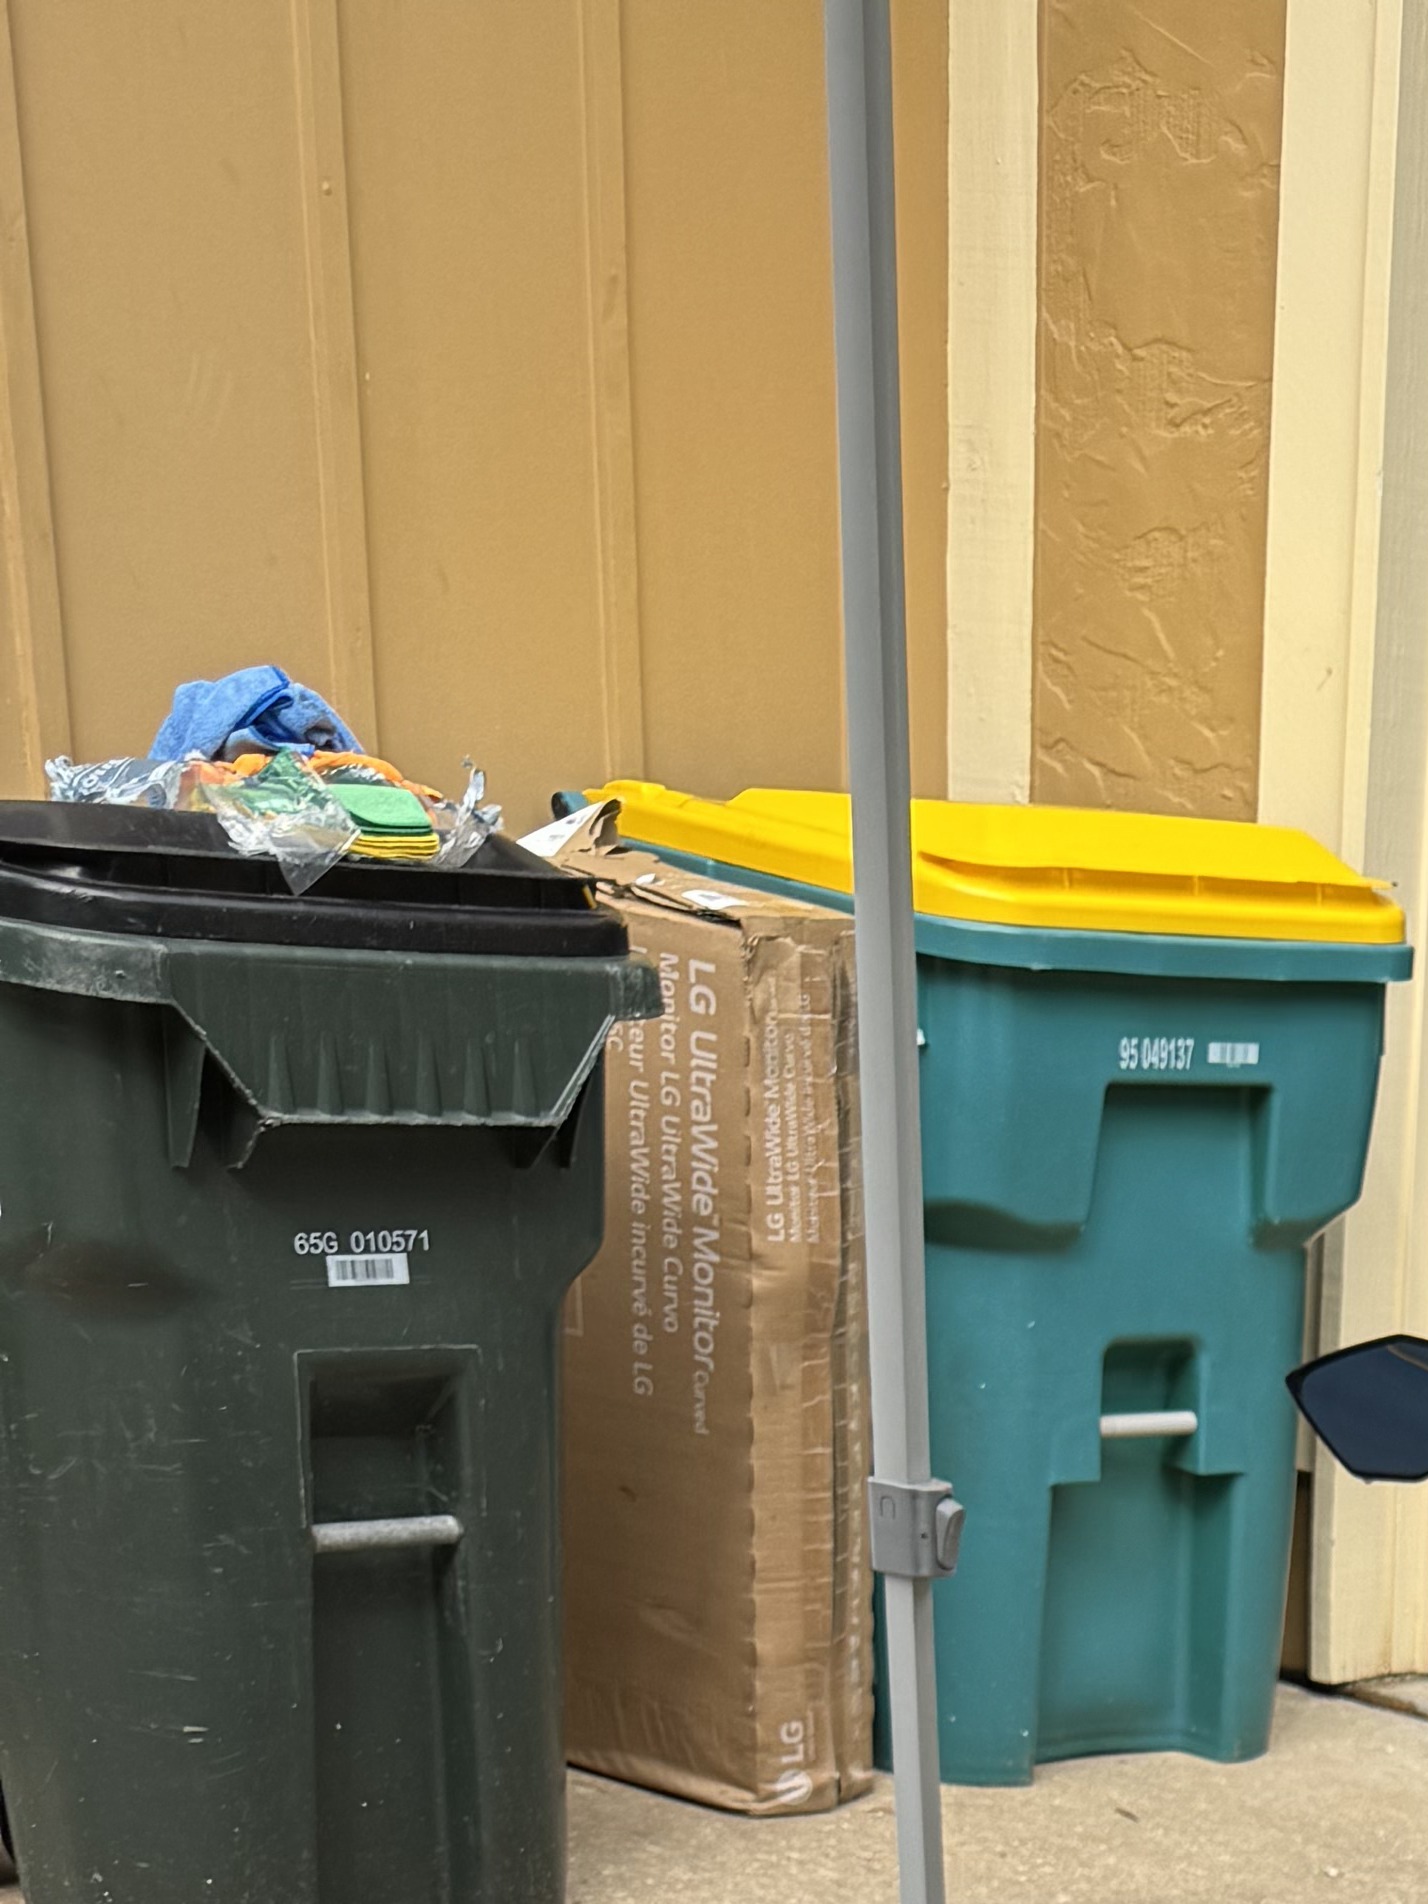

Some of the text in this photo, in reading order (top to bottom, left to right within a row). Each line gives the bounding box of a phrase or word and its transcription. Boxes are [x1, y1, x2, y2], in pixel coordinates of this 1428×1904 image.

[688, 959, 716, 1016] LG
[1119, 1037, 1195, 1070] 95 049137
[660, 1071, 681, 1107] LG
[628, 1079, 650, 1215] UltraWide
[660, 1116, 682, 1249] UltraWide
[294, 1229, 430, 1255] 65G 010571
[766, 1213, 785, 1242] LG
[630, 1221, 651, 1317] incurvé
[662, 1257, 683, 1333] Curvo
[692, 1226, 721, 1372] Monitor
[632, 1325, 653, 1355] de
[632, 1362, 654, 1396] LG
[781, 1721, 804, 1763] LG
